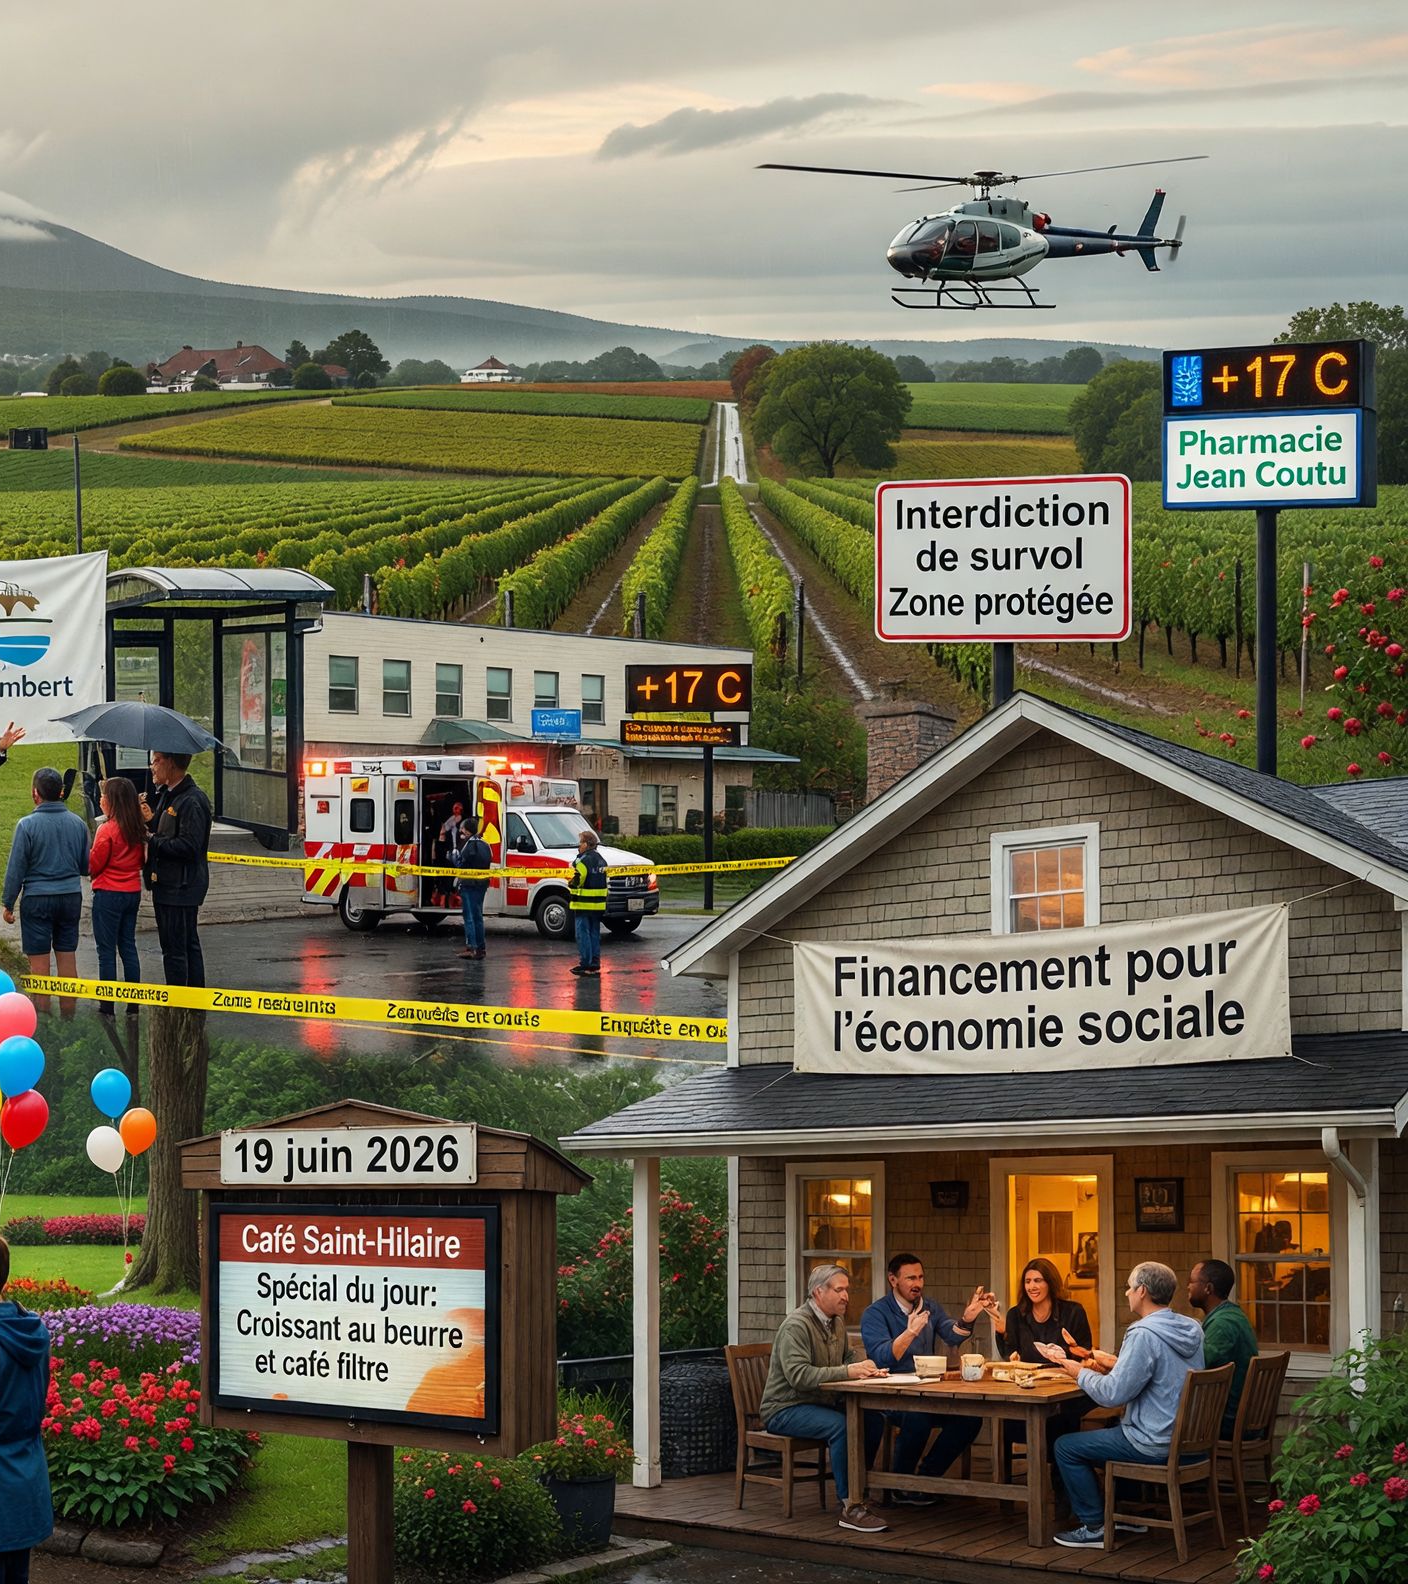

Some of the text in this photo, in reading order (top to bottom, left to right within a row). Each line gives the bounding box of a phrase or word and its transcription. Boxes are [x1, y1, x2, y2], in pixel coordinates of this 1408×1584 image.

[1211, 351, 1349, 398] +17 C
[1178, 424, 1343, 456] Pharmacie
[1176, 460, 1347, 490] Jean Coutu
[895, 493, 1110, 530] Interdiction
[915, 536, 1084, 573] de survol
[888, 582, 1114, 625] Zone protégée
[636, 670, 743, 705] +17 C
[834, 939, 1237, 998] Financement pour
[834, 989, 1246, 1053] l'économie sociale
[234, 1134, 459, 1184] 19 juin 2026
[241, 1223, 461, 1260] Café Saint-Hilaire
[256, 1272, 438, 1312] Spécial du jour:
[236, 1309, 464, 1350] Croissant au beurre
[254, 1349, 390, 1383] et café filtre
